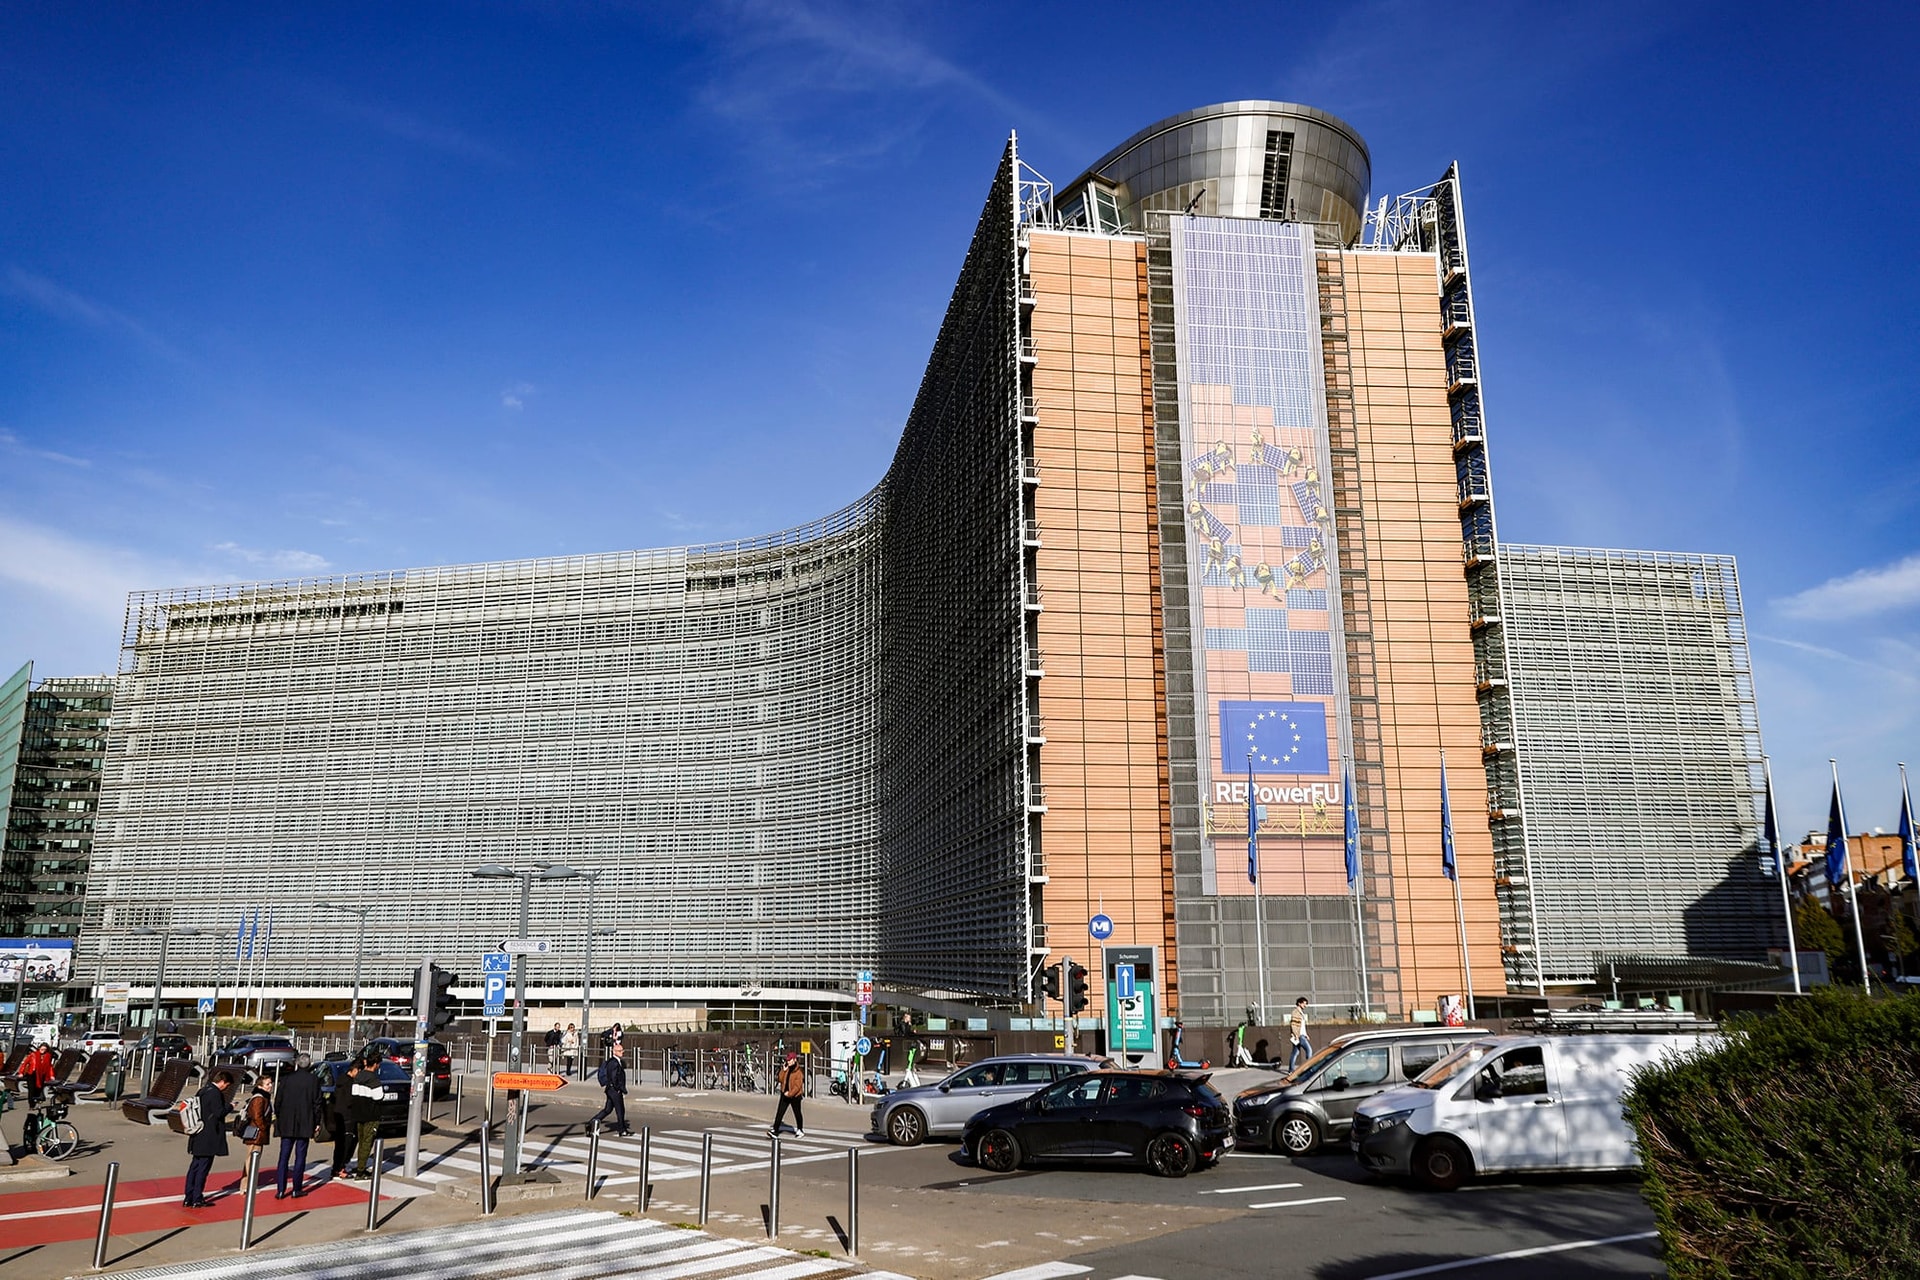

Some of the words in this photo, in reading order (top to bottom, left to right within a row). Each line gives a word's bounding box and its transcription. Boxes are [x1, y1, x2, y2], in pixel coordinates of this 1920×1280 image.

[1215, 782, 1340, 804] REPowerEU
[487, 977, 504, 1001] P
[486, 1006, 503, 1015] TAXIS
